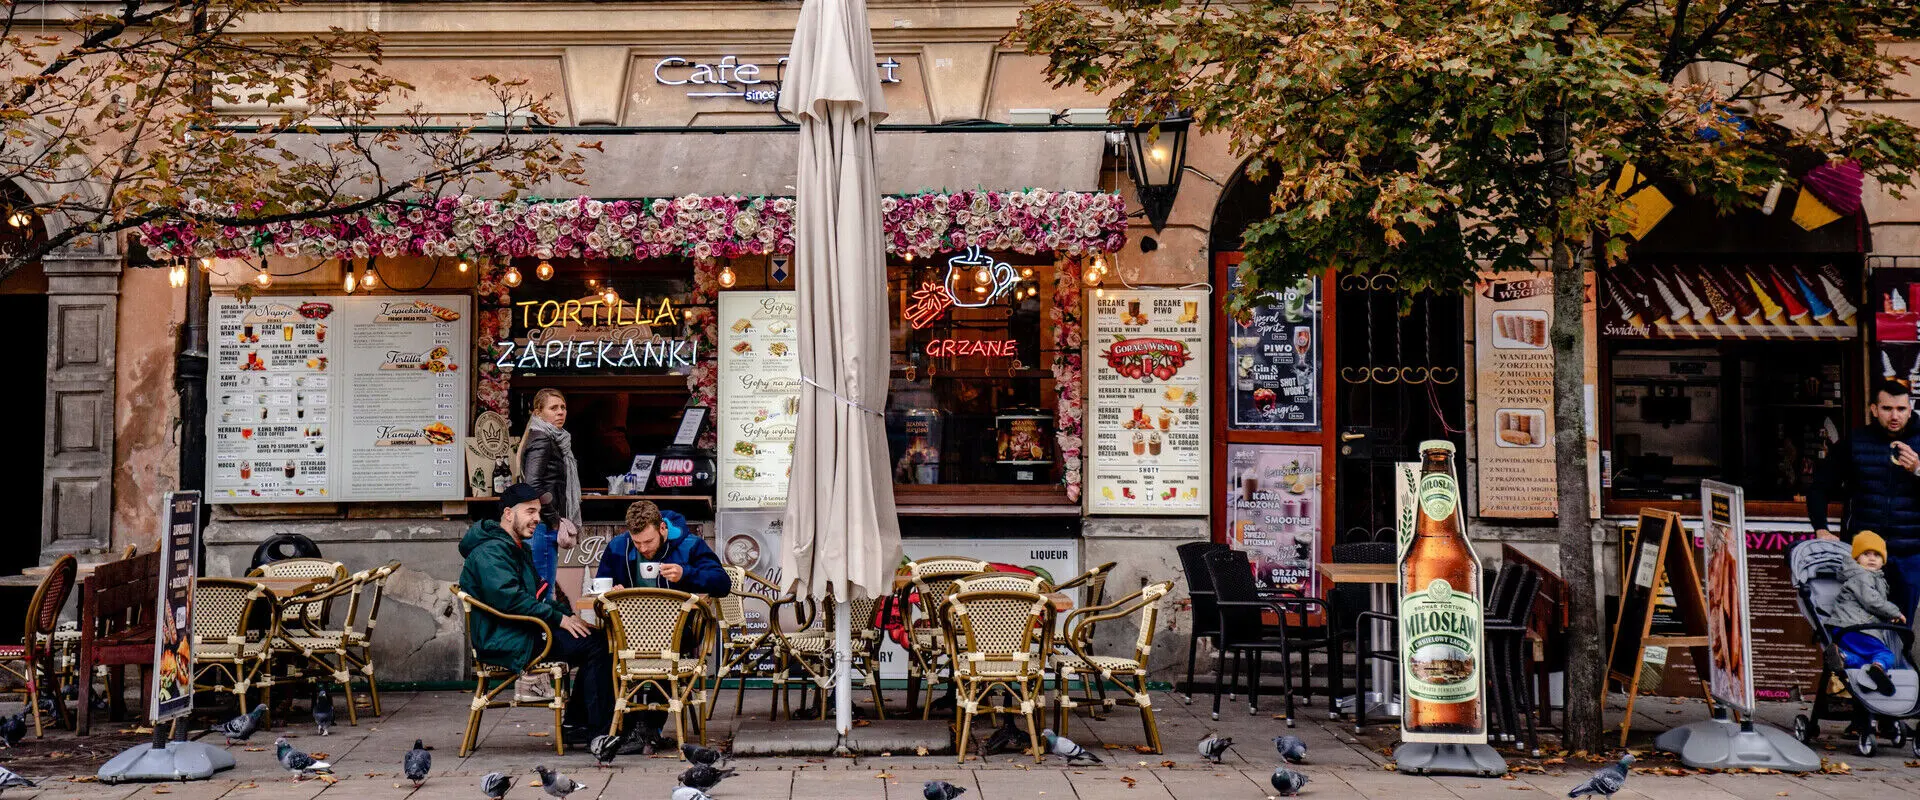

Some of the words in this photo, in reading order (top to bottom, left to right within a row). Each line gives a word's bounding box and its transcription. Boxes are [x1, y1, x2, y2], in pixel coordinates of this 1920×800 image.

[654, 55, 761, 85] Cafe
[745, 90, 775, 100] since
[1500, 288, 1554, 300] WĘGIER
[760, 298, 793, 314] Gofry
[1097, 299, 1125, 307] GRZANE
[1153, 299, 1181, 307] GRZANE
[516, 297, 677, 328] TORTILLA
[1602, 321, 1650, 336] Świderki
[496, 338, 698, 368] ZAPIEKANKI
[926, 339, 1017, 357] GRZANE
[1263, 344, 1292, 352] PIWO
[386, 350, 421, 364] Tortilla
[1253, 364, 1269, 373] Gin
[739, 374, 769, 389] Gofry
[1254, 372, 1279, 381] Tonic
[1280, 377, 1297, 387] SHOT
[1262, 404, 1300, 419] Sangria
[376, 425, 422, 440] Kanapki
[740, 423, 769, 437] Gofry
[660, 459, 694, 473] WINO
[1252, 492, 1281, 500] KAWA
[1237, 501, 1281, 509] MROŻONA
[1265, 516, 1311, 525] SMOOTHIE
[1243, 524, 1256, 532] SOK
[1243, 538, 1277, 546] WYCISKANY
[1030, 550, 1068, 560] LIQUEUR
[1272, 568, 1310, 577] GRZANE
[1272, 576, 1298, 584] WINO
[1440, 604, 1467, 612] FORTUNA
[1405, 611, 1477, 643] MIŁOSŁAW
[1449, 637, 1468, 649] LAGER
